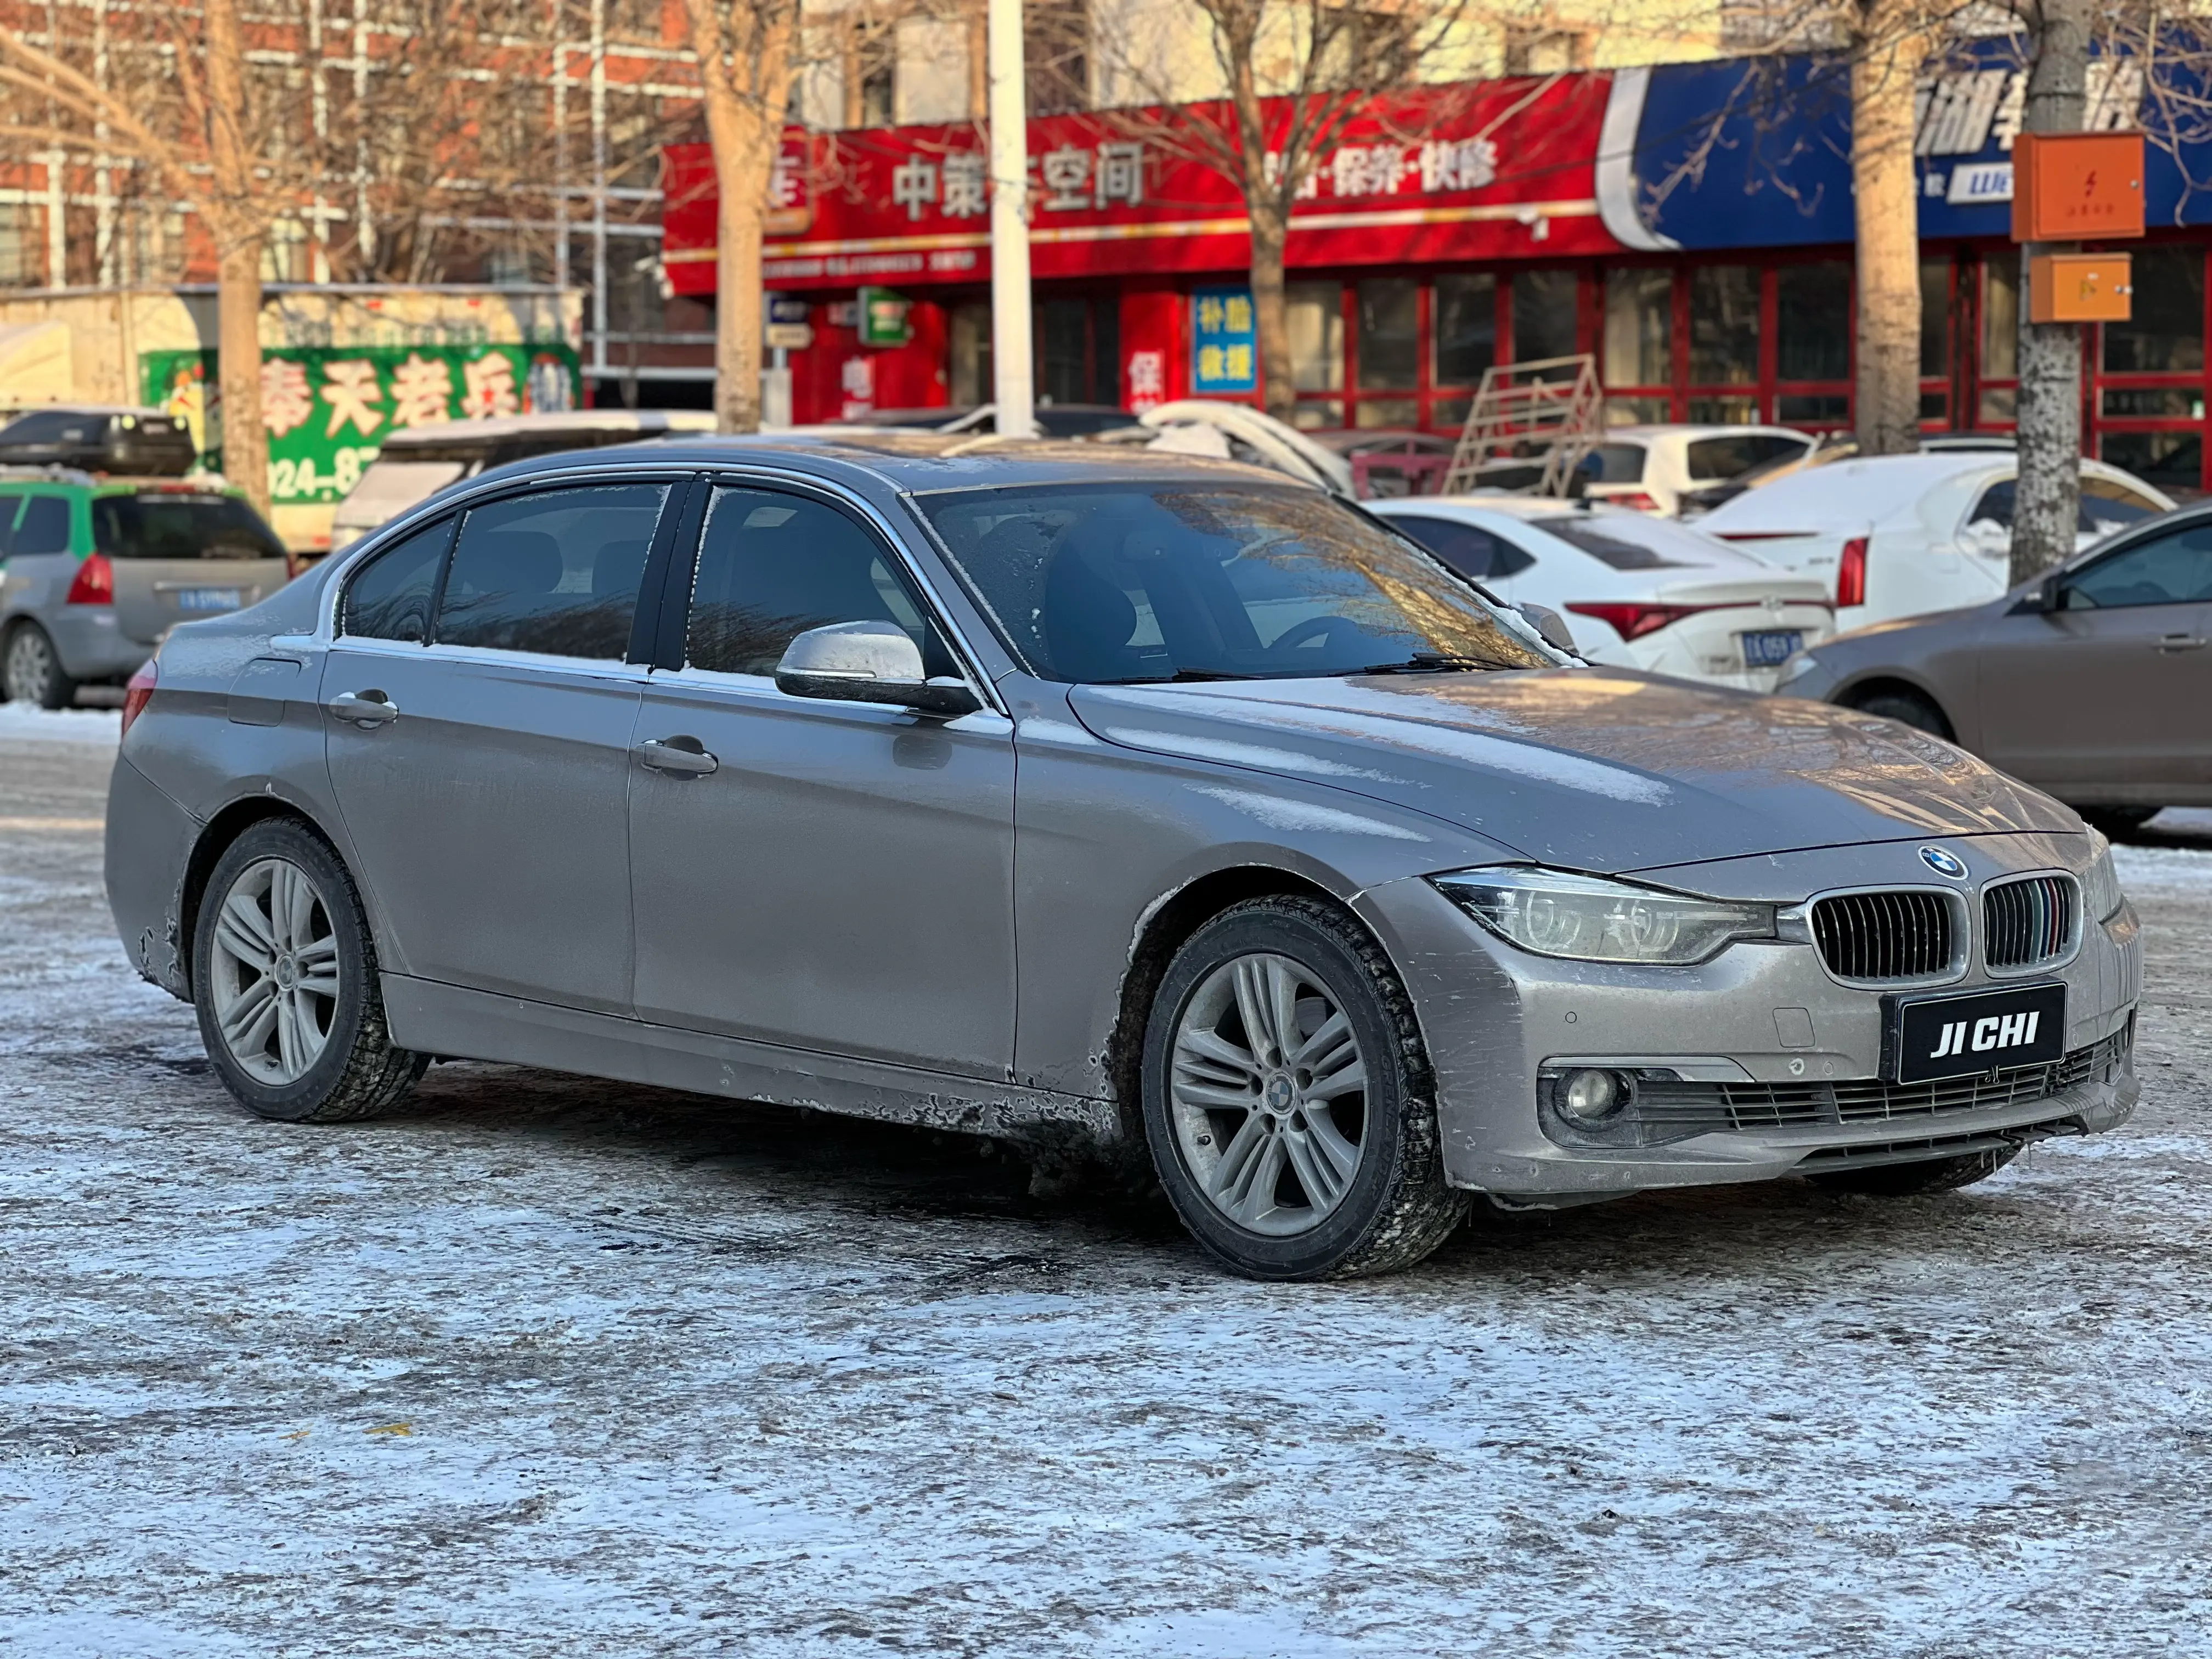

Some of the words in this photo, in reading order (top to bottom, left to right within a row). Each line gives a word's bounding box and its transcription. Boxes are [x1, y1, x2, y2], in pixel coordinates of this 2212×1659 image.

[893, 144, 1143, 221] 中策空间
[1930, 1021, 1967, 1059] JI
[1972, 1011, 2040, 1052] CHI
